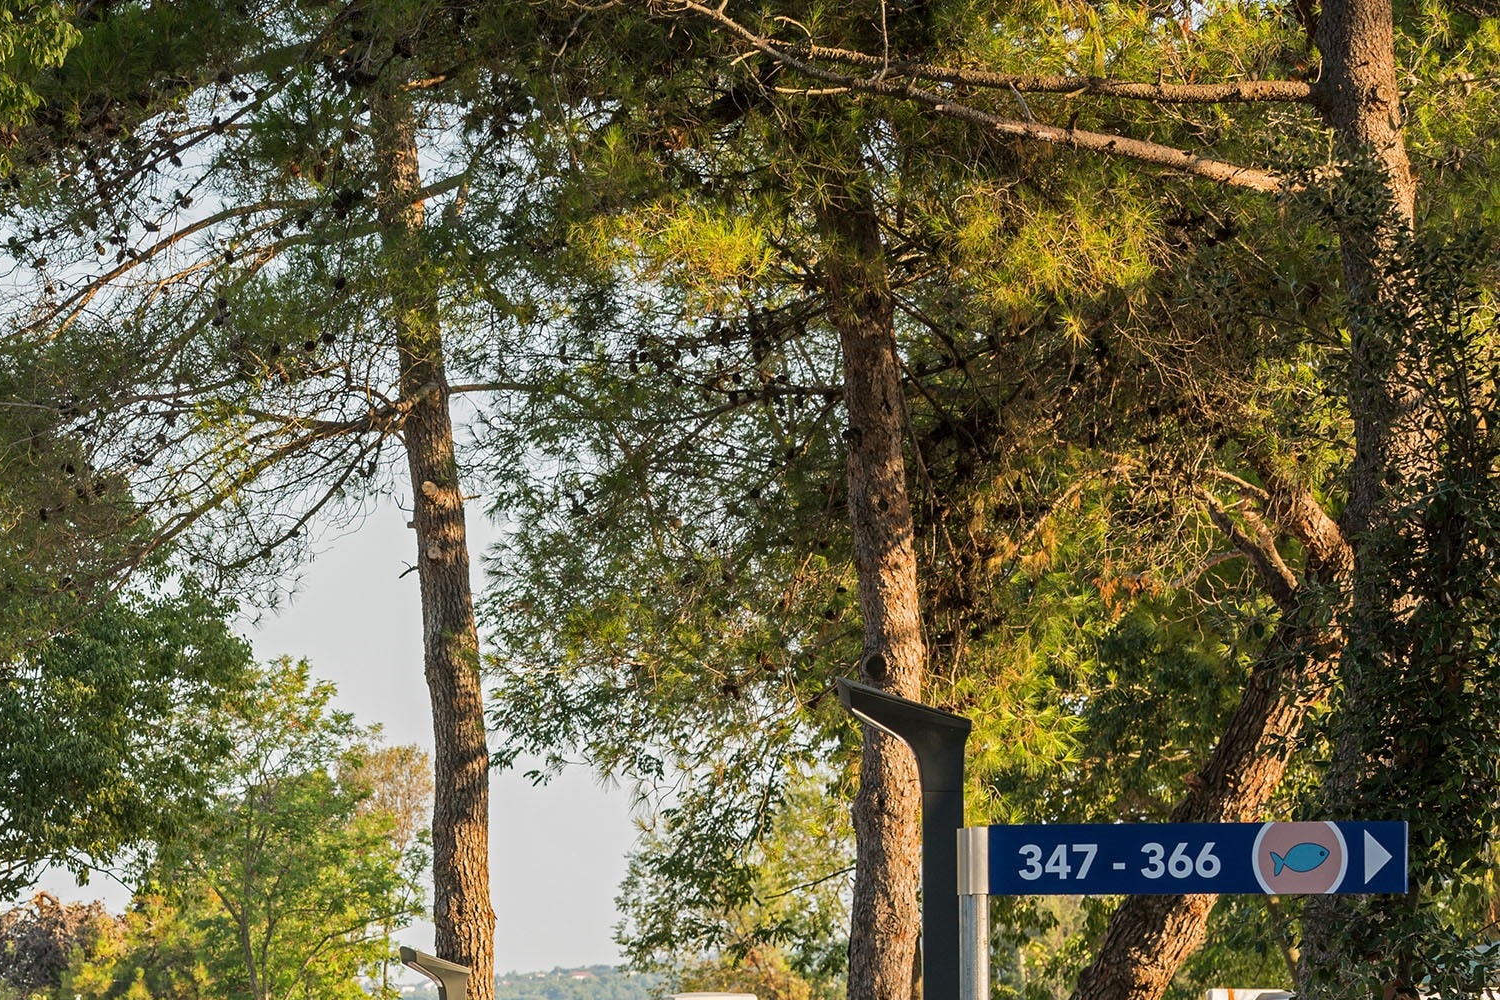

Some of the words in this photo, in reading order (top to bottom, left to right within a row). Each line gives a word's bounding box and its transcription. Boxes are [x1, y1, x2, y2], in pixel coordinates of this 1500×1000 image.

[1018, 844, 1098, 881] 347
[1113, 862, 1126, 870] -
[1140, 842, 1221, 879] 366
